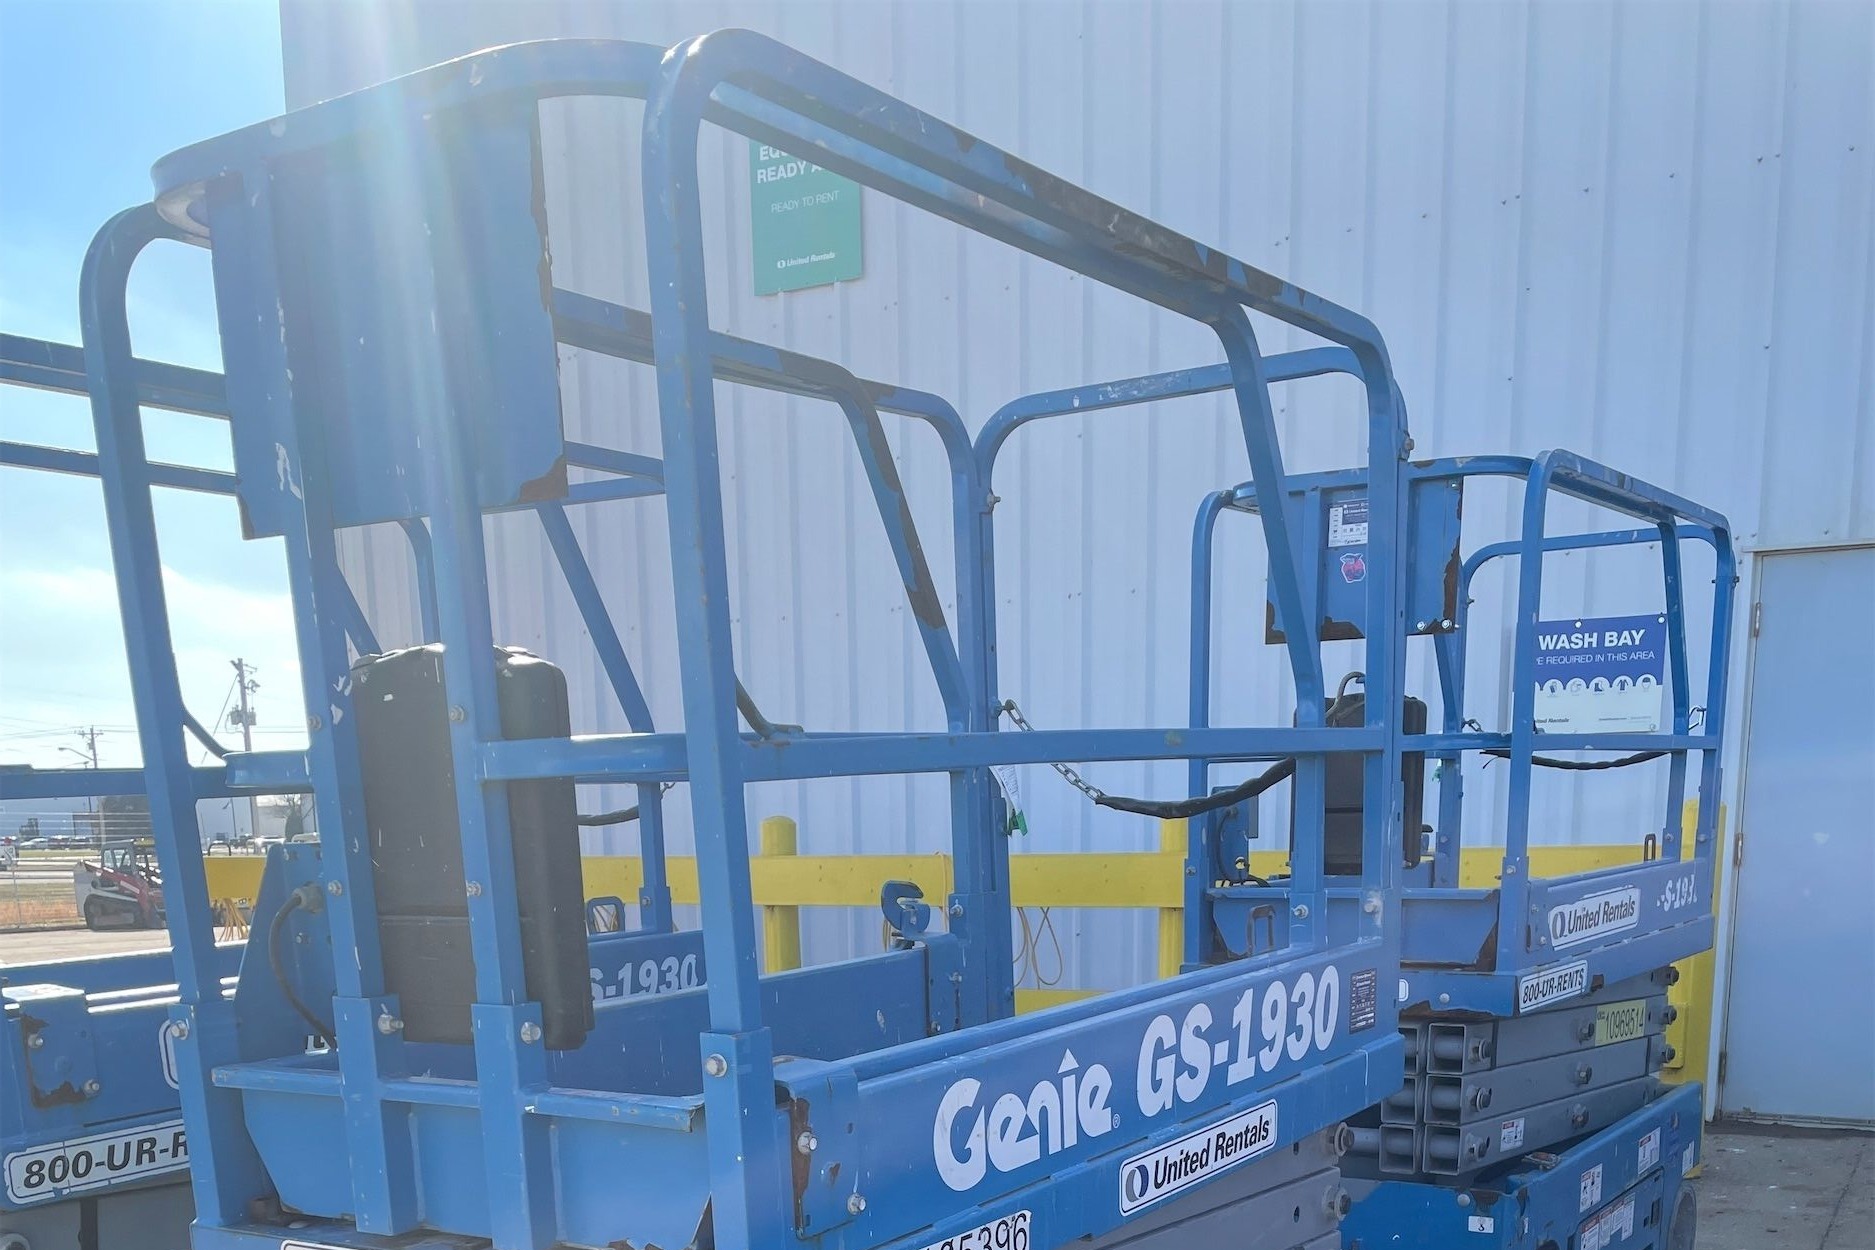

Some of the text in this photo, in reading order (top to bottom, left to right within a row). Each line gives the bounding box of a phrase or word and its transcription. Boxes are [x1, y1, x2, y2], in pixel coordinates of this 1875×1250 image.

[757, 160, 806, 184] READY
[771, 190, 840, 214] READY TO RENT
[1538, 629, 1646, 651] WASH BAY
[1546, 653, 1593, 665] REQUIRED
[1595, 653, 1605, 663] IN
[1607, 651, 1627, 662] THIS
[1629, 650, 1655, 660] AREA
[1567, 896, 1637, 935] United Rentals
[1522, 967, 1586, 1005] 800-UR-RENTS
[1605, 1007, 1645, 1040] 10969514
[933, 1047, 1114, 1192] Genie
[1136, 965, 1340, 1118] GS-1930
[1153, 1115, 1271, 1190] United Rentals
